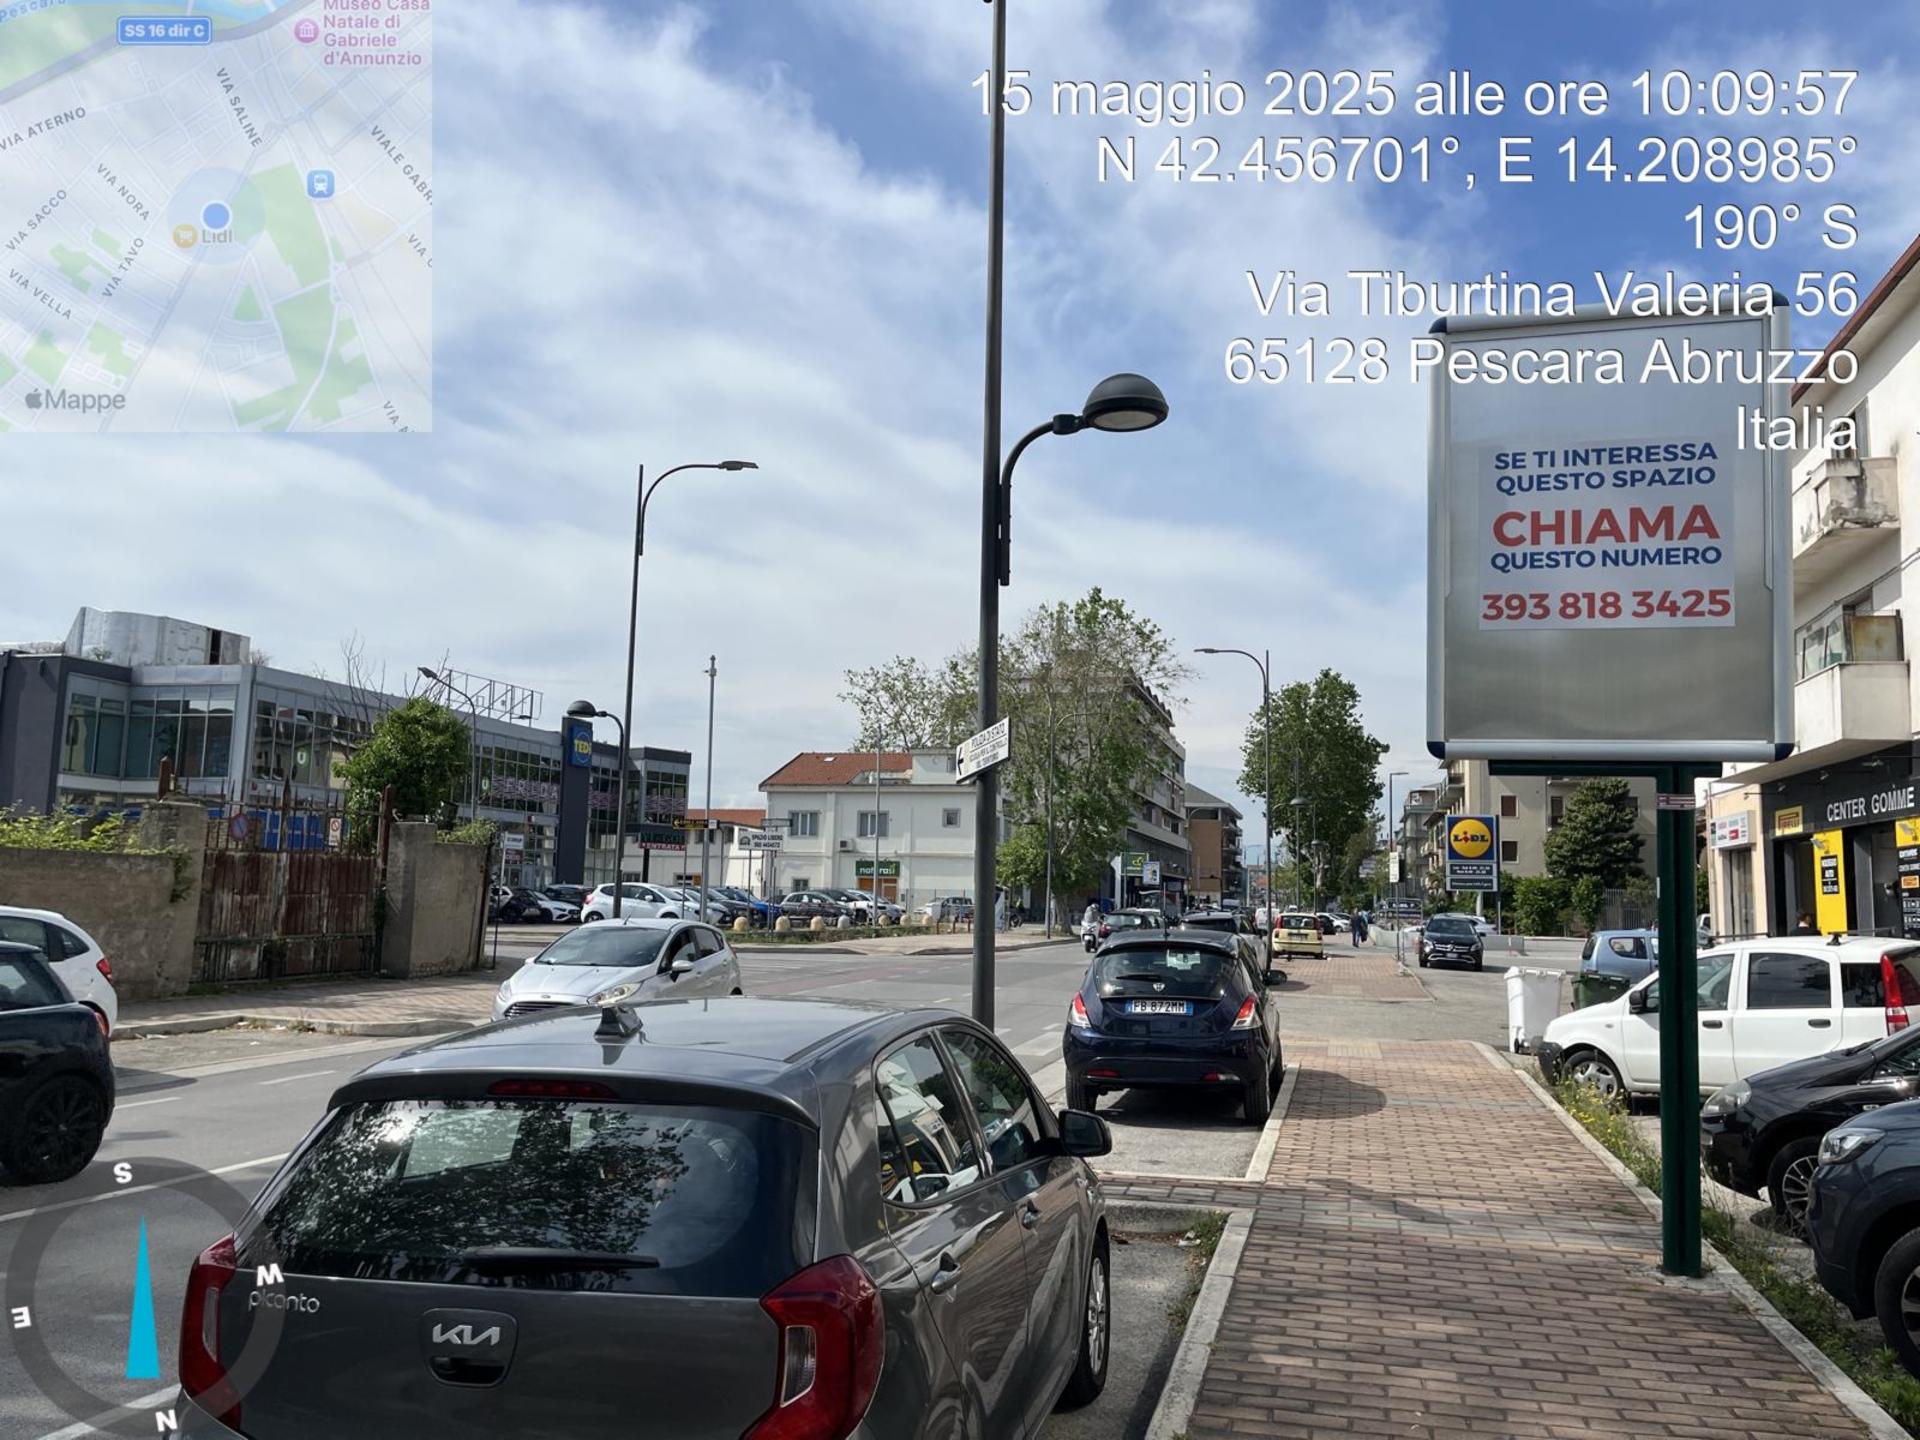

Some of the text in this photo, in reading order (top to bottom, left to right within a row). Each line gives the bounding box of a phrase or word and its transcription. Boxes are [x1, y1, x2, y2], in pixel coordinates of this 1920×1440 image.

[1494, 442, 1718, 470] SE TI INTERESSA
[1496, 466, 1716, 496] QUESTO SPAZIO
[1493, 504, 1720, 547] CHIAMA
[1491, 546, 1722, 573] QUESTO NUMERO
[1482, 589, 1732, 621] 393 818 3425
[1826, 786, 1915, 822] CENTER GOMME
[1134, 1001, 1148, 1012] FB
